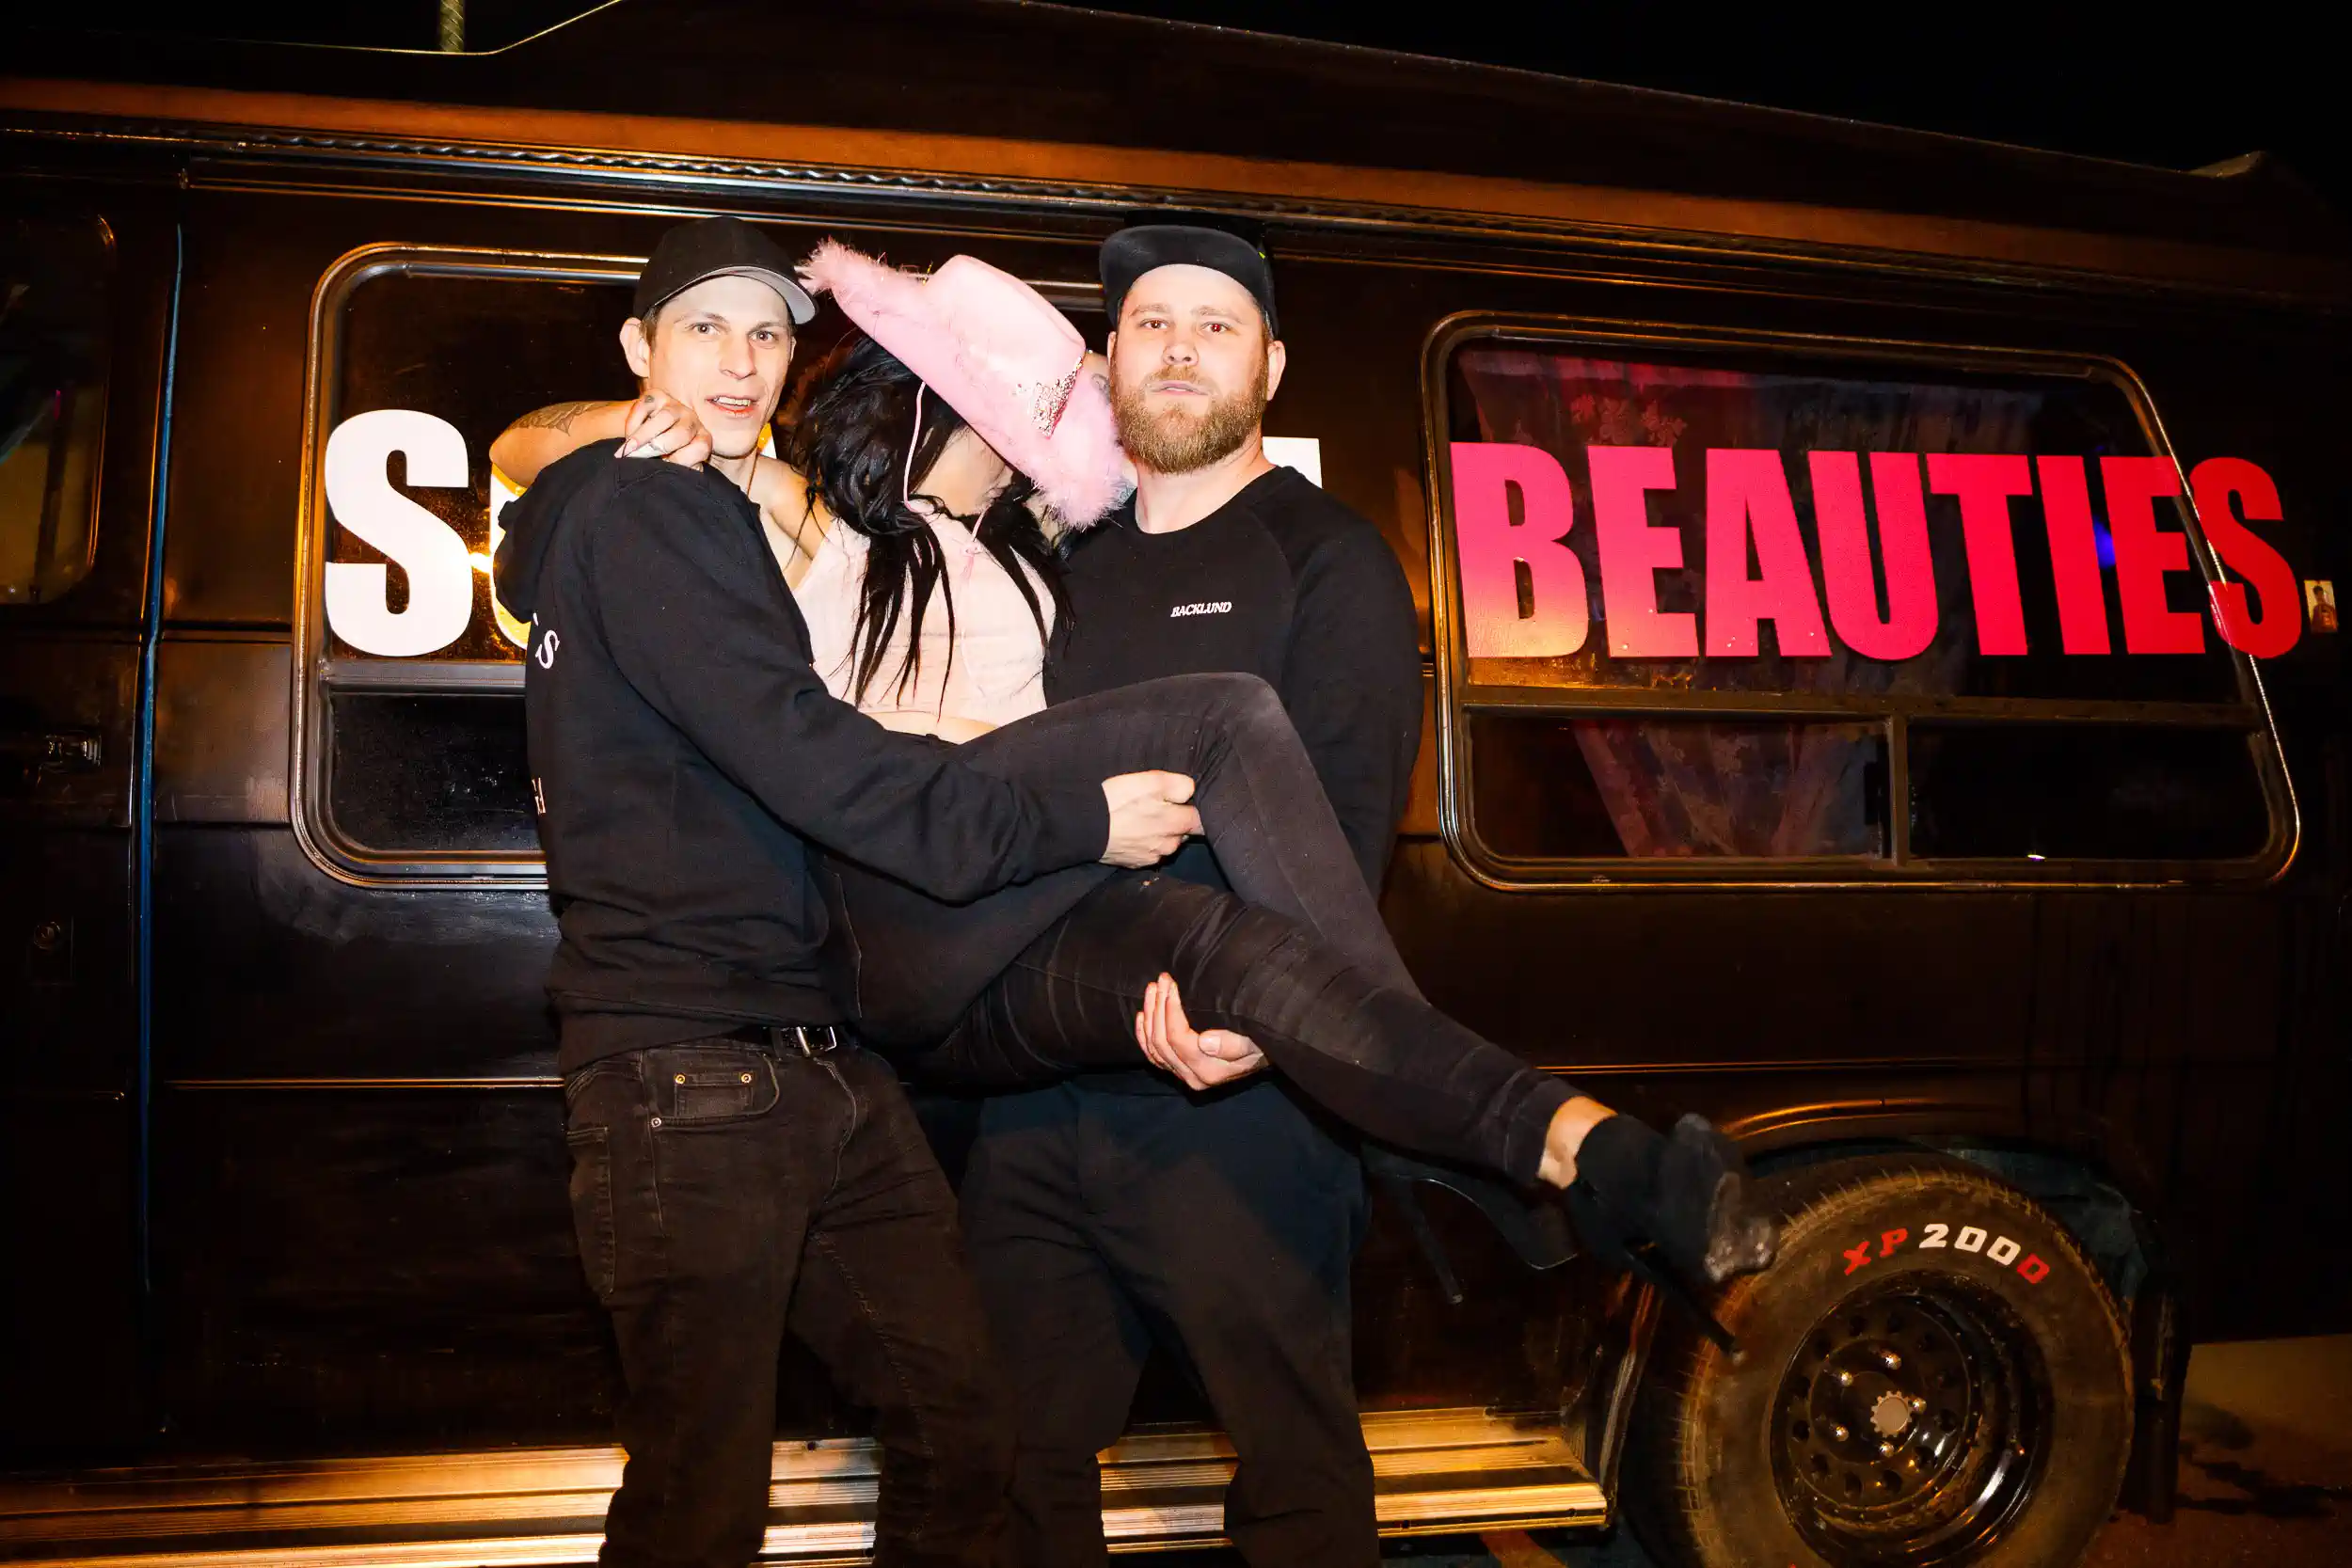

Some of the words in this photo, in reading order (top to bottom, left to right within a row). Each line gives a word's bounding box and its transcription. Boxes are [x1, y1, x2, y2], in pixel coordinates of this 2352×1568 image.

[1450, 441, 2302, 660] BEAUTIES
[1169, 600, 1232, 618] BACKLUND
[1842, 1227, 1909, 1276] XP
[1918, 1223, 2051, 1285] 2000
